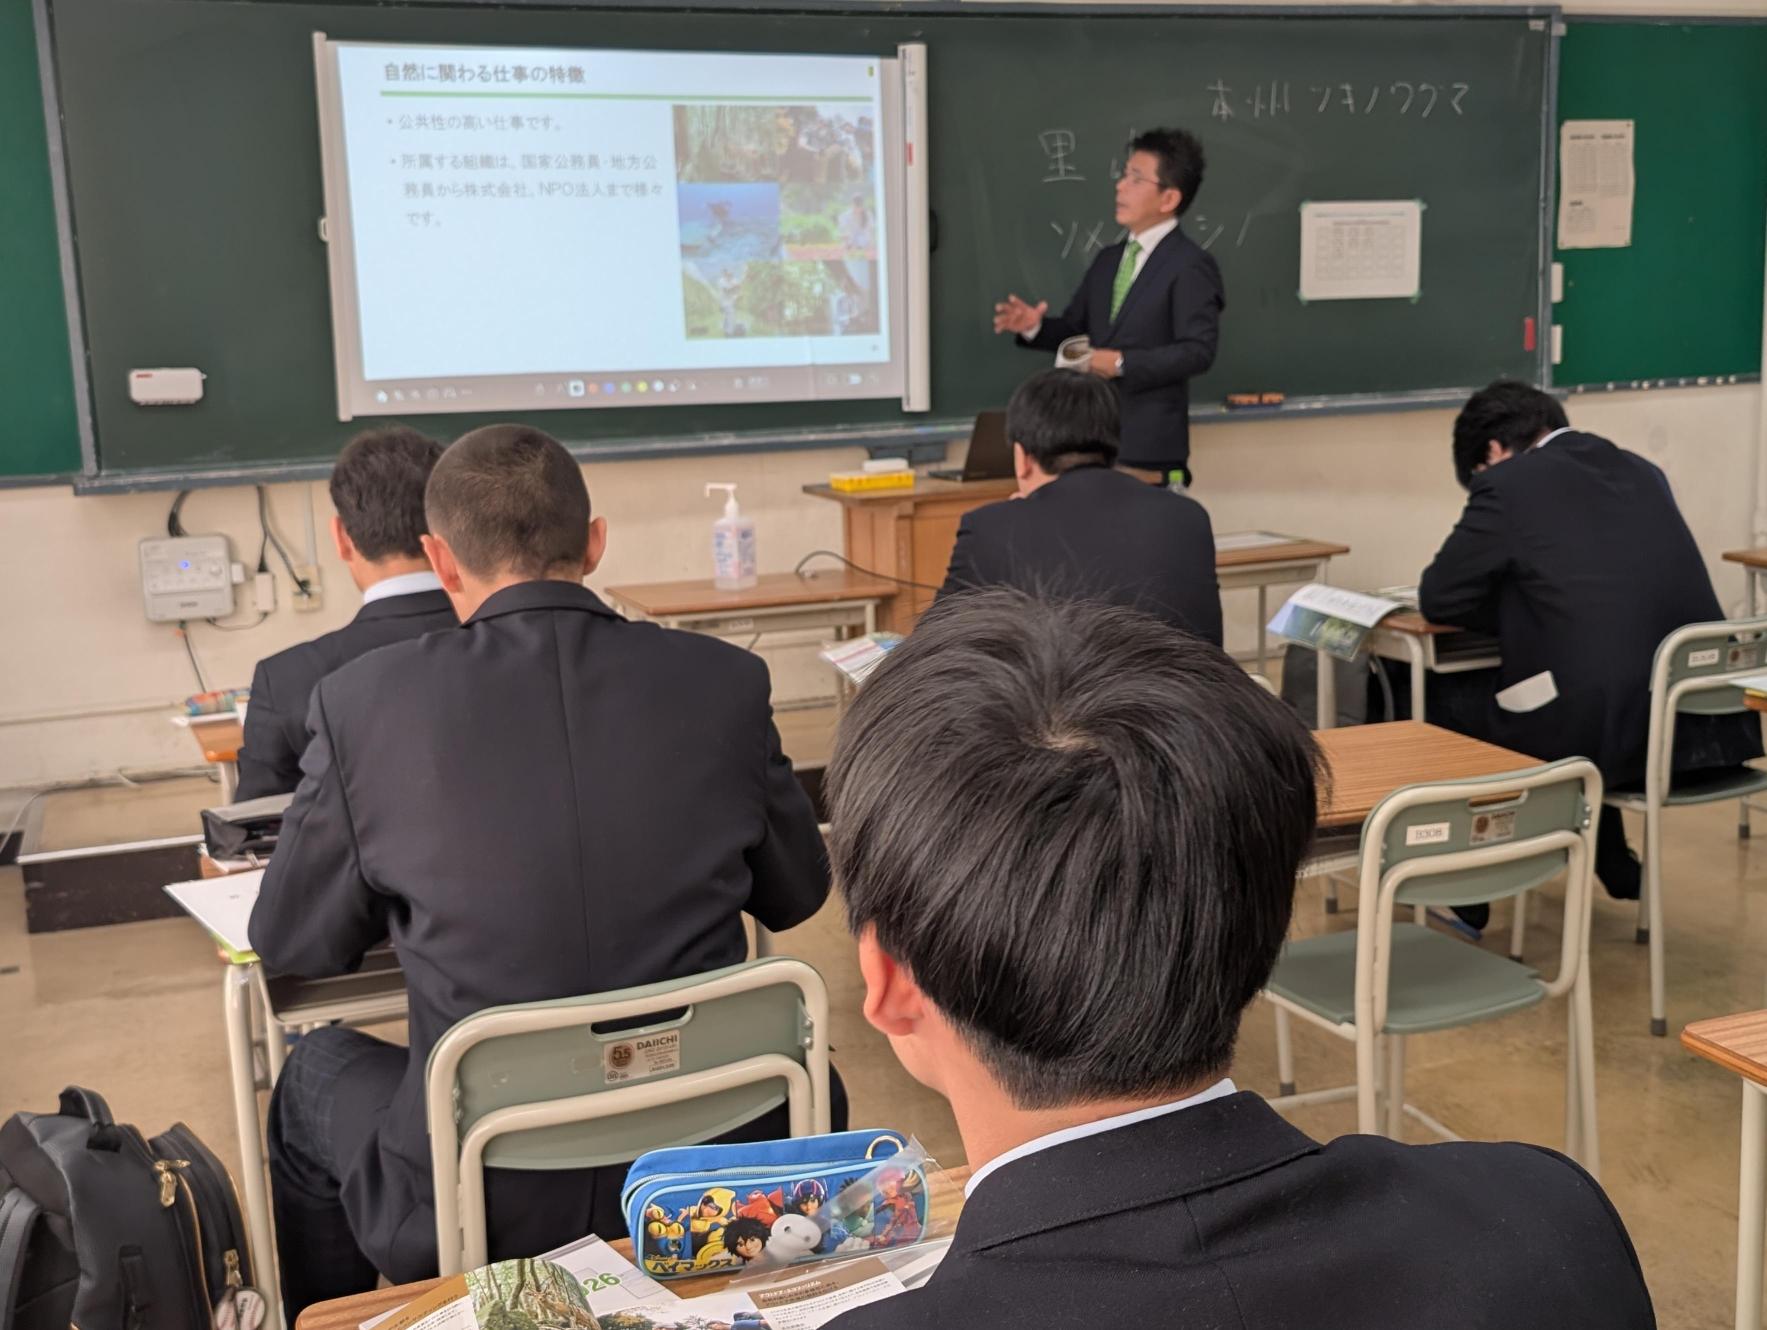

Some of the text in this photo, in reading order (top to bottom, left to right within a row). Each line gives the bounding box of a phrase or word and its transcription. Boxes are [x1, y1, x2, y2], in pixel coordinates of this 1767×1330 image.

[384, 63, 586, 83] 自然に関わる仕事の特徴
[406, 210, 443, 227] です。
[637, 1034, 678, 1050] DAIICHI
